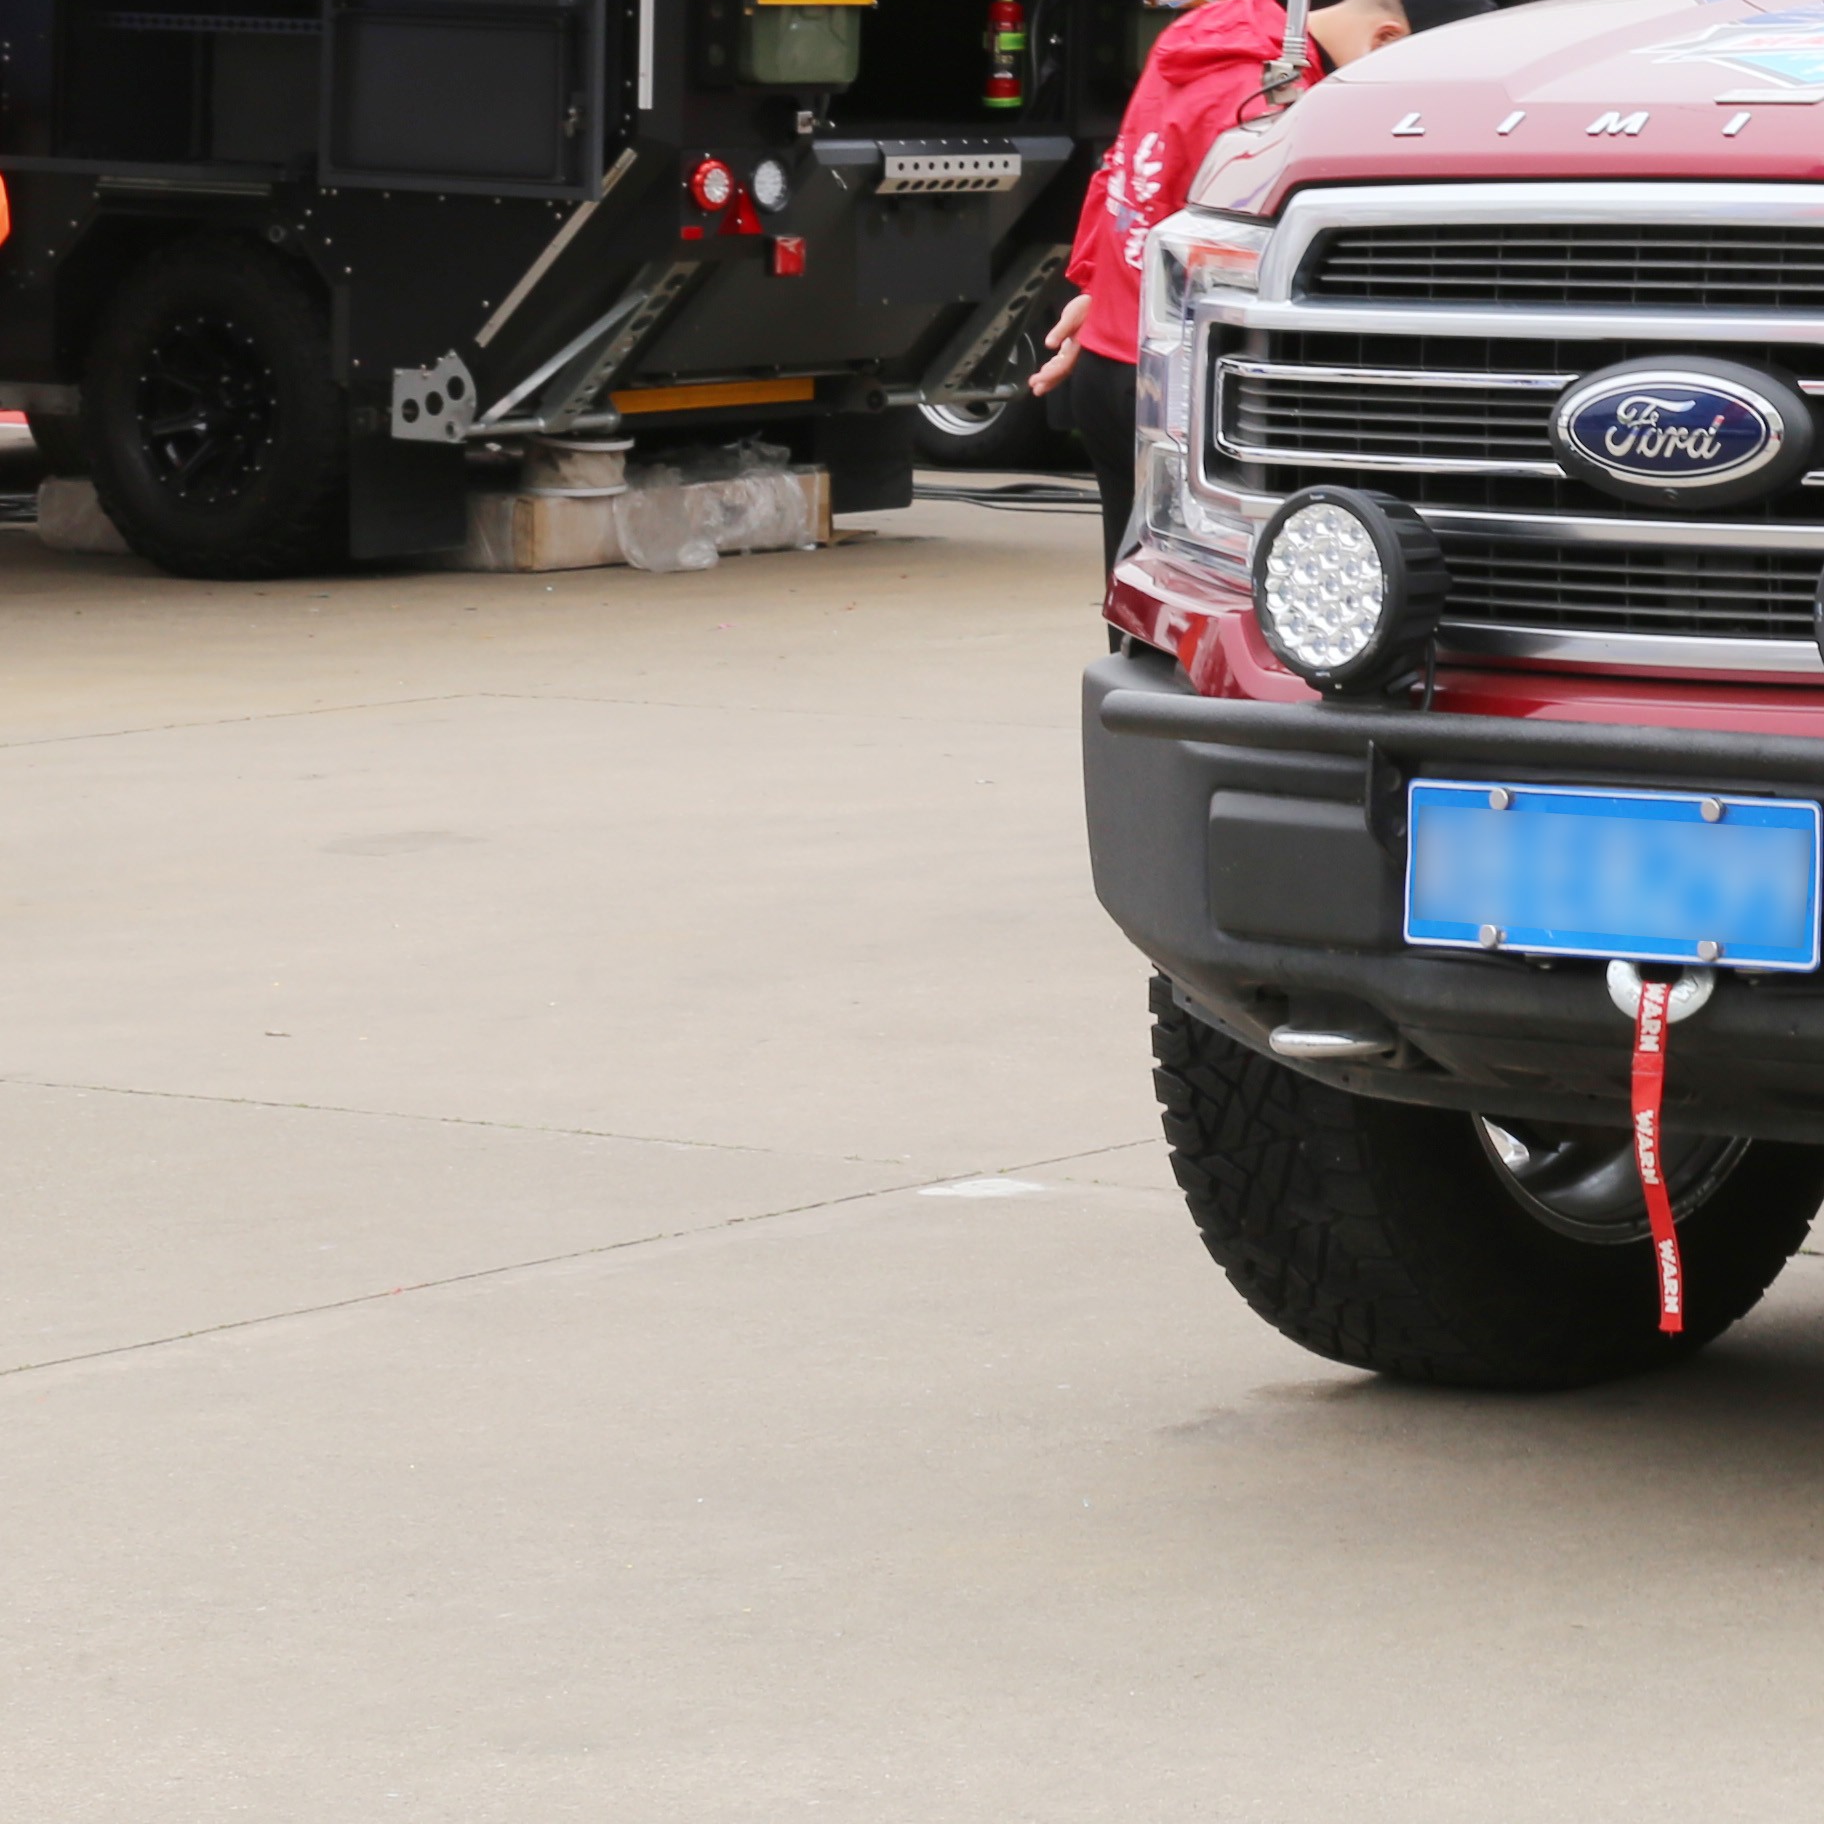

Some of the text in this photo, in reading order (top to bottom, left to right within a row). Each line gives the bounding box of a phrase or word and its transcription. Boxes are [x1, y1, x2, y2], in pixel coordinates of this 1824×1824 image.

[1603, 394, 1727, 461] Ford
[1638, 981, 1668, 1053] WARN
[1634, 1108, 1661, 1186] WARN
[1657, 1237, 1681, 1315] WARN
